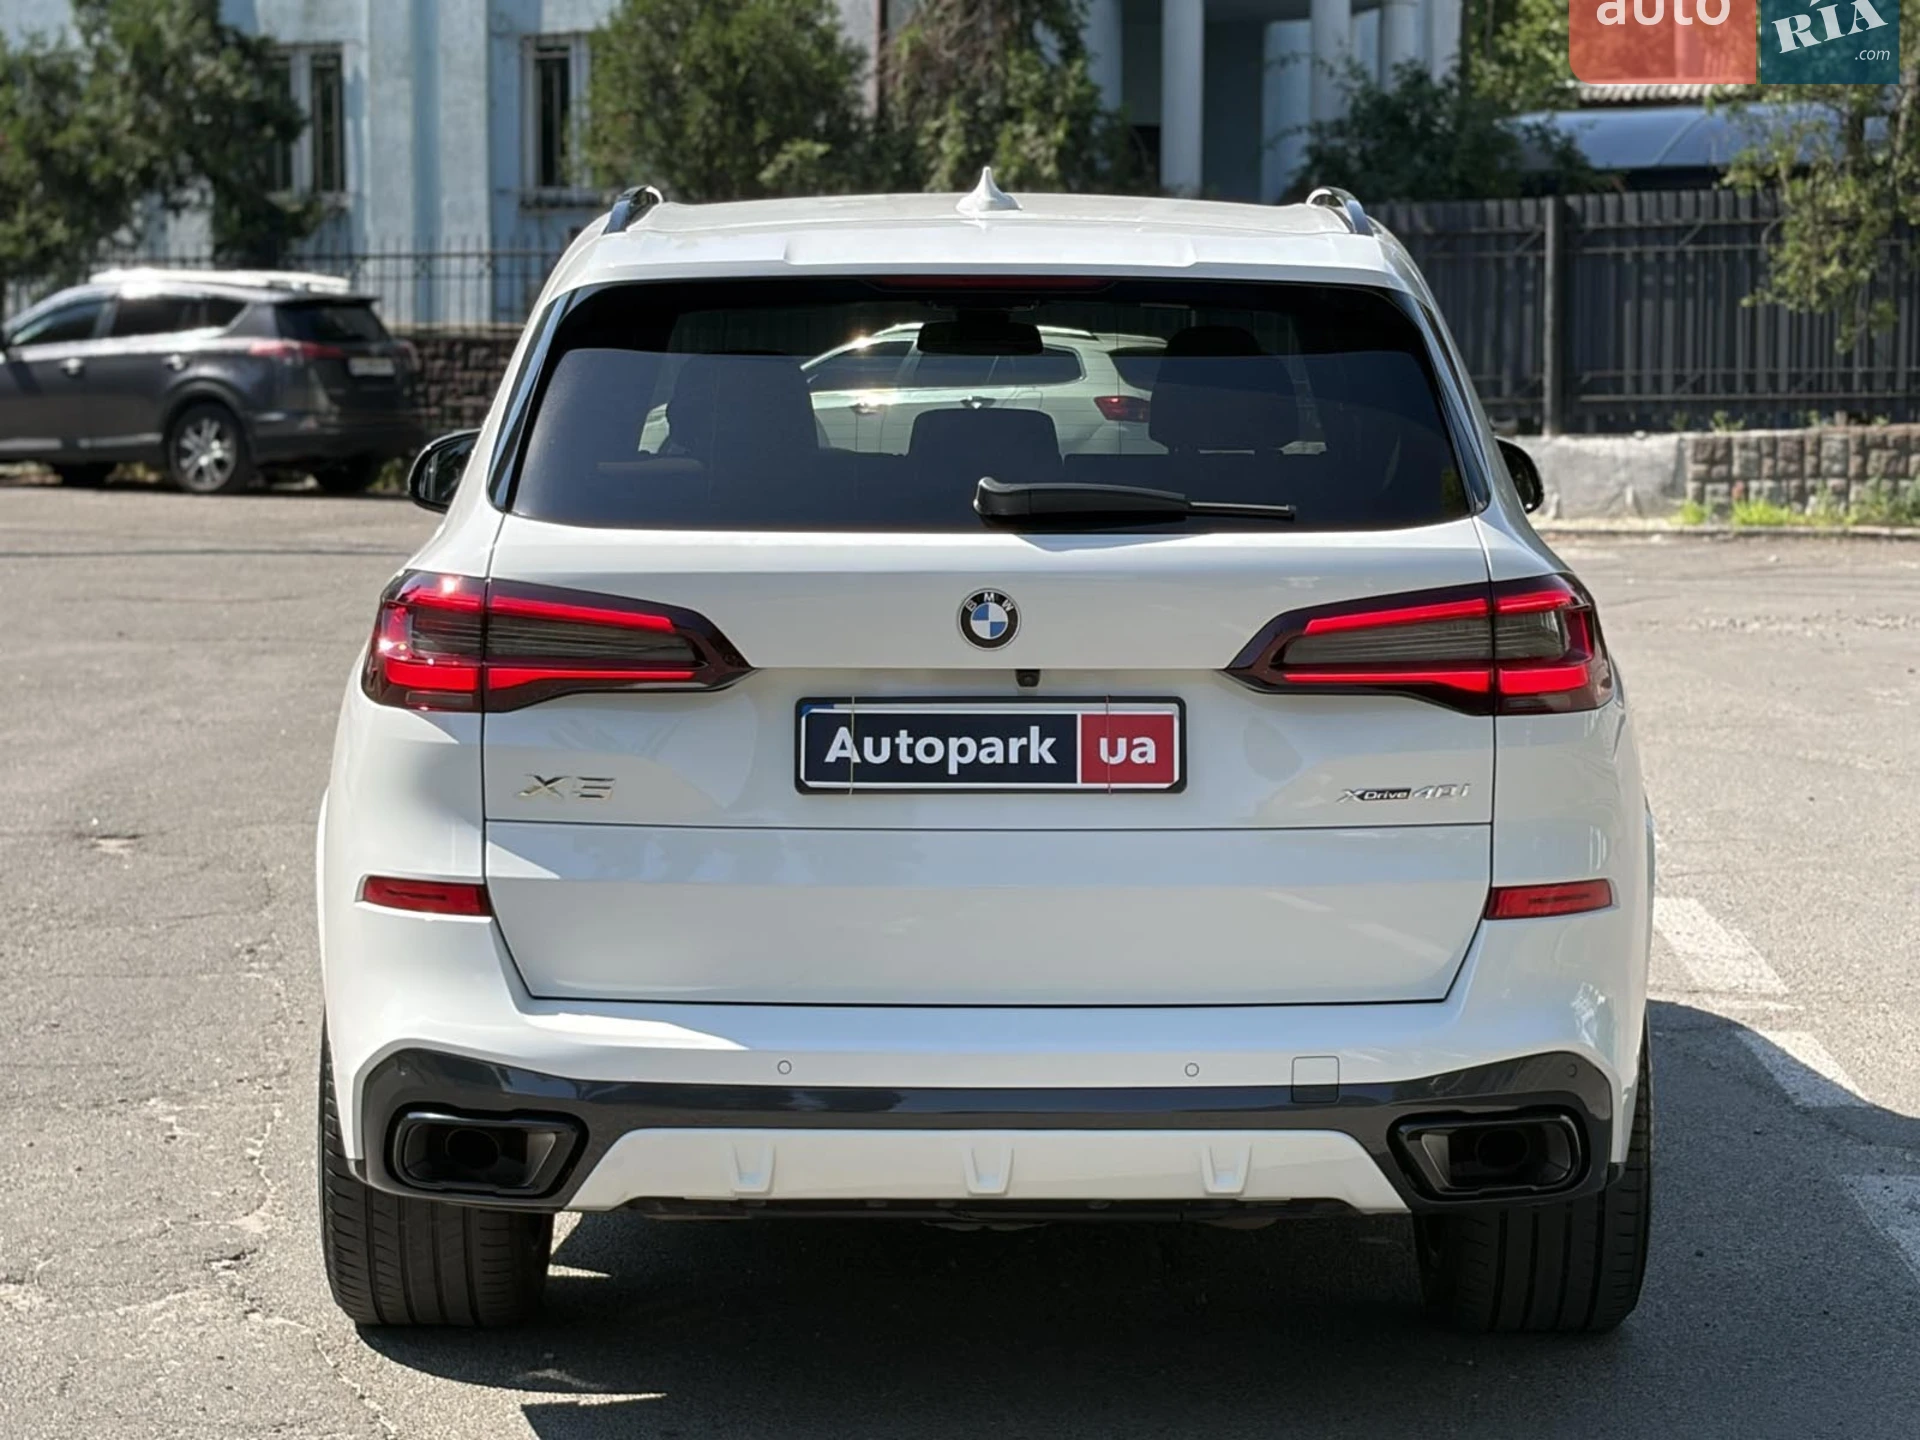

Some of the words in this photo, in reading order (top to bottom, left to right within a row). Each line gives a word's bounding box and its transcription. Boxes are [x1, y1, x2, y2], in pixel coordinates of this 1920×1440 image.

[965, 592, 1014, 612] BMW
[824, 726, 1057, 775] Autopark
[1100, 734, 1156, 765] ua
[518, 773, 616, 801] X5
